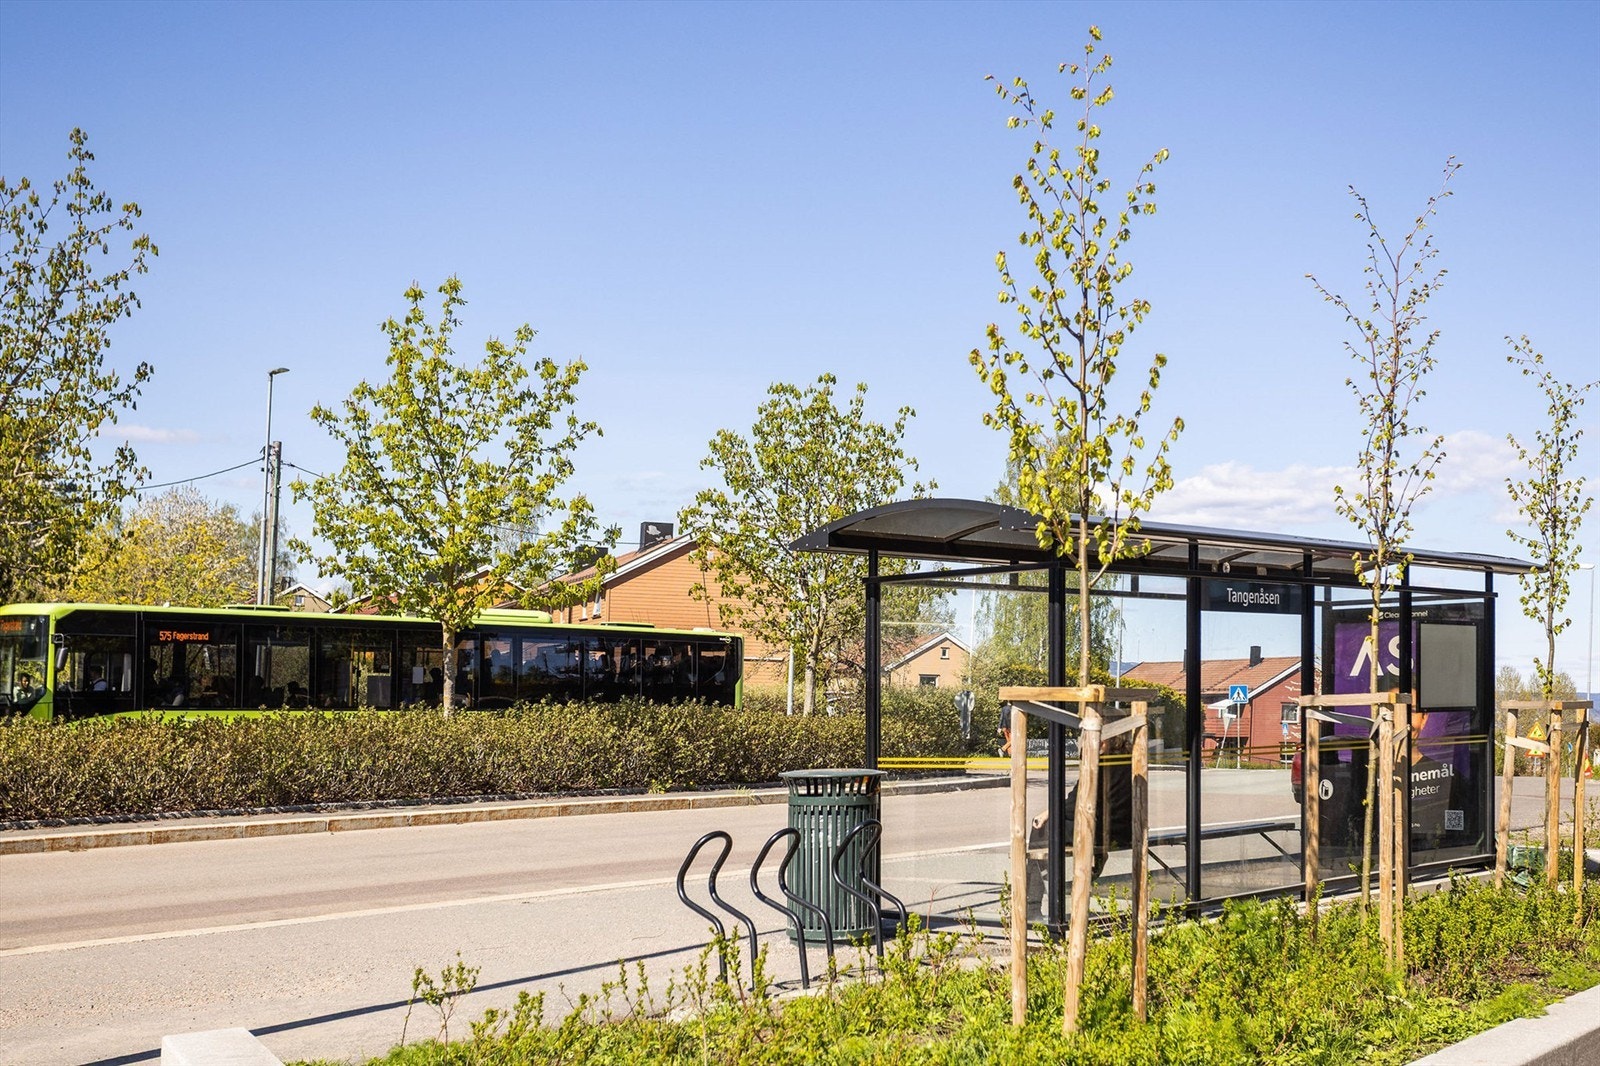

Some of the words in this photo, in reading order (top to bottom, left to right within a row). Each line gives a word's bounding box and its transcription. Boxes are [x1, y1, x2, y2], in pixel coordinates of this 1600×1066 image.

[1226, 588, 1280, 606] Tangenåsen
[159, 631, 172, 641] 575
[173, 631, 209, 641] Fagerstrand
